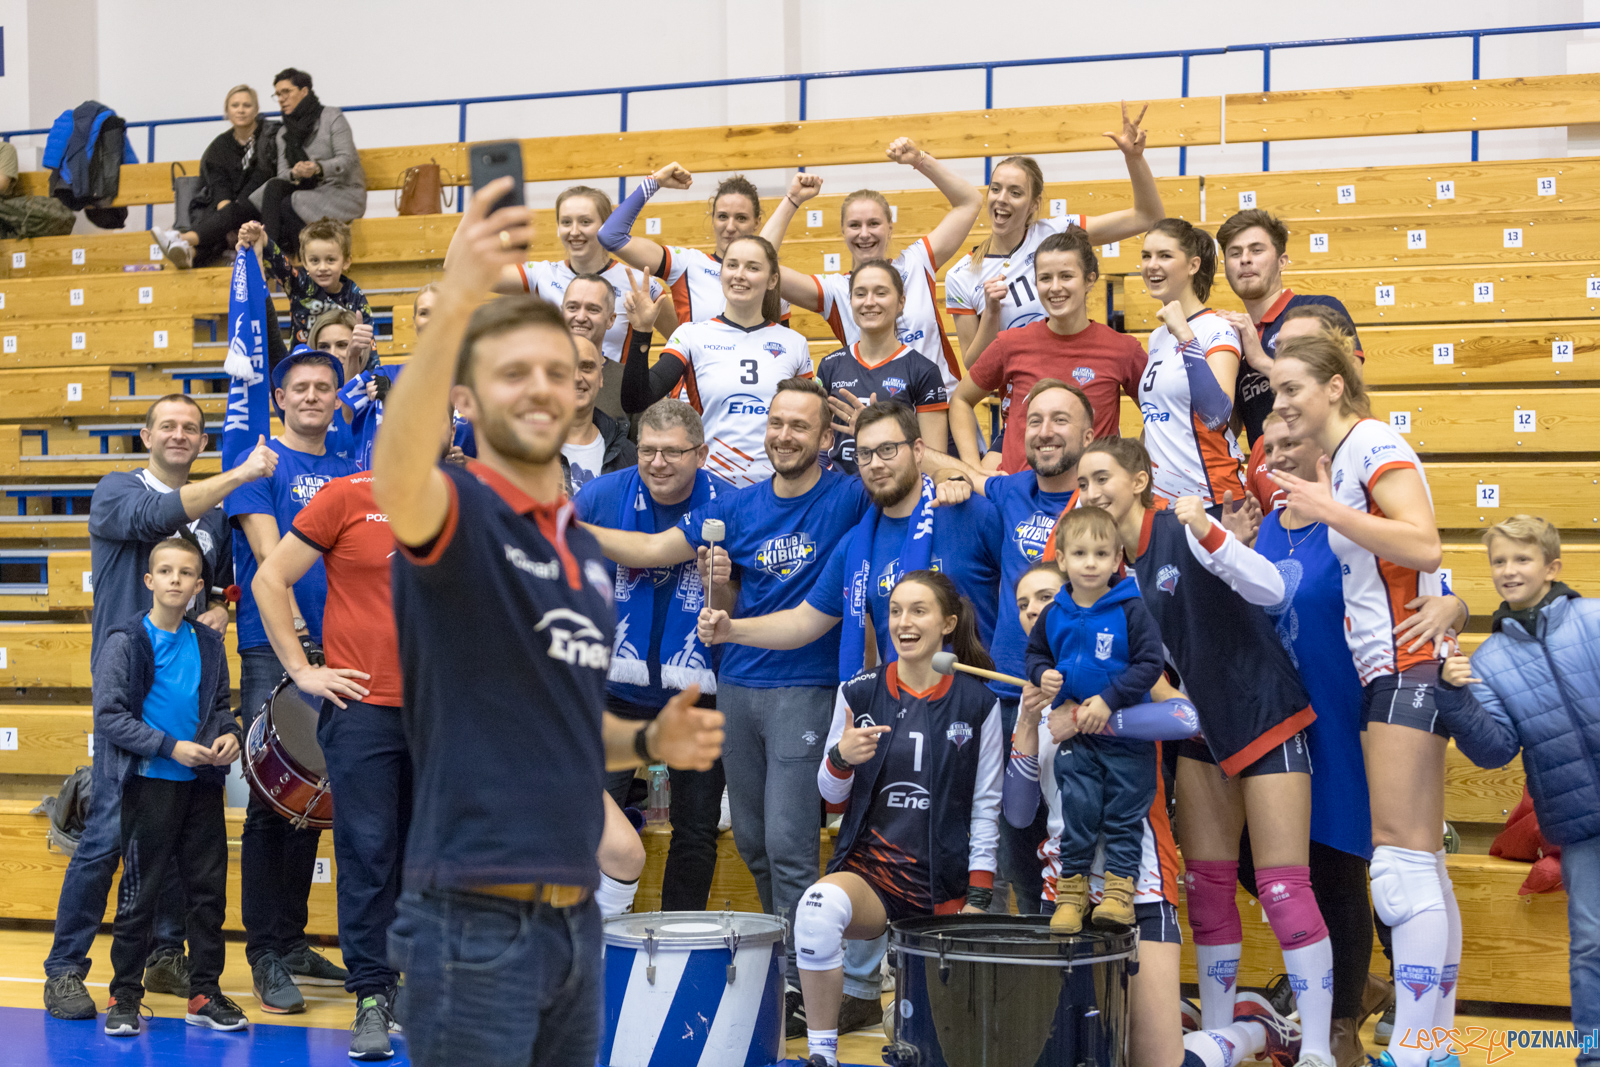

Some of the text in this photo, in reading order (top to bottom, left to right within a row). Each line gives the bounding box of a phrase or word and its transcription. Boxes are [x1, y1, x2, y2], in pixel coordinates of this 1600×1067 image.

[1440, 184, 1450, 193] 14
[1541, 180, 1552, 189] 13
[1342, 188, 1352, 197] 15
[1243, 193, 1252, 203] 16
[1055, 201, 1061, 210] 2
[812, 212, 818, 222] 5
[651, 220, 656, 229] 7
[1412, 233, 1422, 243] 14
[1508, 231, 1518, 241] 13
[1314, 237, 1324, 246] 15
[829, 256, 835, 265] 4
[704, 268, 721, 277] POZ
[1008, 275, 1036, 308] 17
[1380, 289, 1390, 299] 14
[1478, 286, 1489, 296] 13
[158, 334, 163, 342] 9
[898, 330, 924, 344] ea
[1438, 347, 1449, 357] 13
[1557, 345, 1569, 355] 12
[740, 359, 758, 385] 3
[1143, 361, 1163, 392] 5
[72, 386, 77, 395] 9
[1242, 380, 1270, 402] Ene
[1395, 416, 1406, 426] 13
[1519, 414, 1531, 424] 12
[1371, 444, 1397, 454] Enea
[297, 485, 320, 498] KIB
[1482, 489, 1494, 500] 12
[366, 514, 389, 522] POZ
[1018, 525, 1052, 542] KIBIC
[775, 535, 798, 550] KLUB
[680, 563, 692, 591] ENEA
[854, 578, 863, 607] ENEA
[6, 732, 12, 742] 7
[887, 791, 930, 810] Ene
[316, 861, 323, 873] 3
